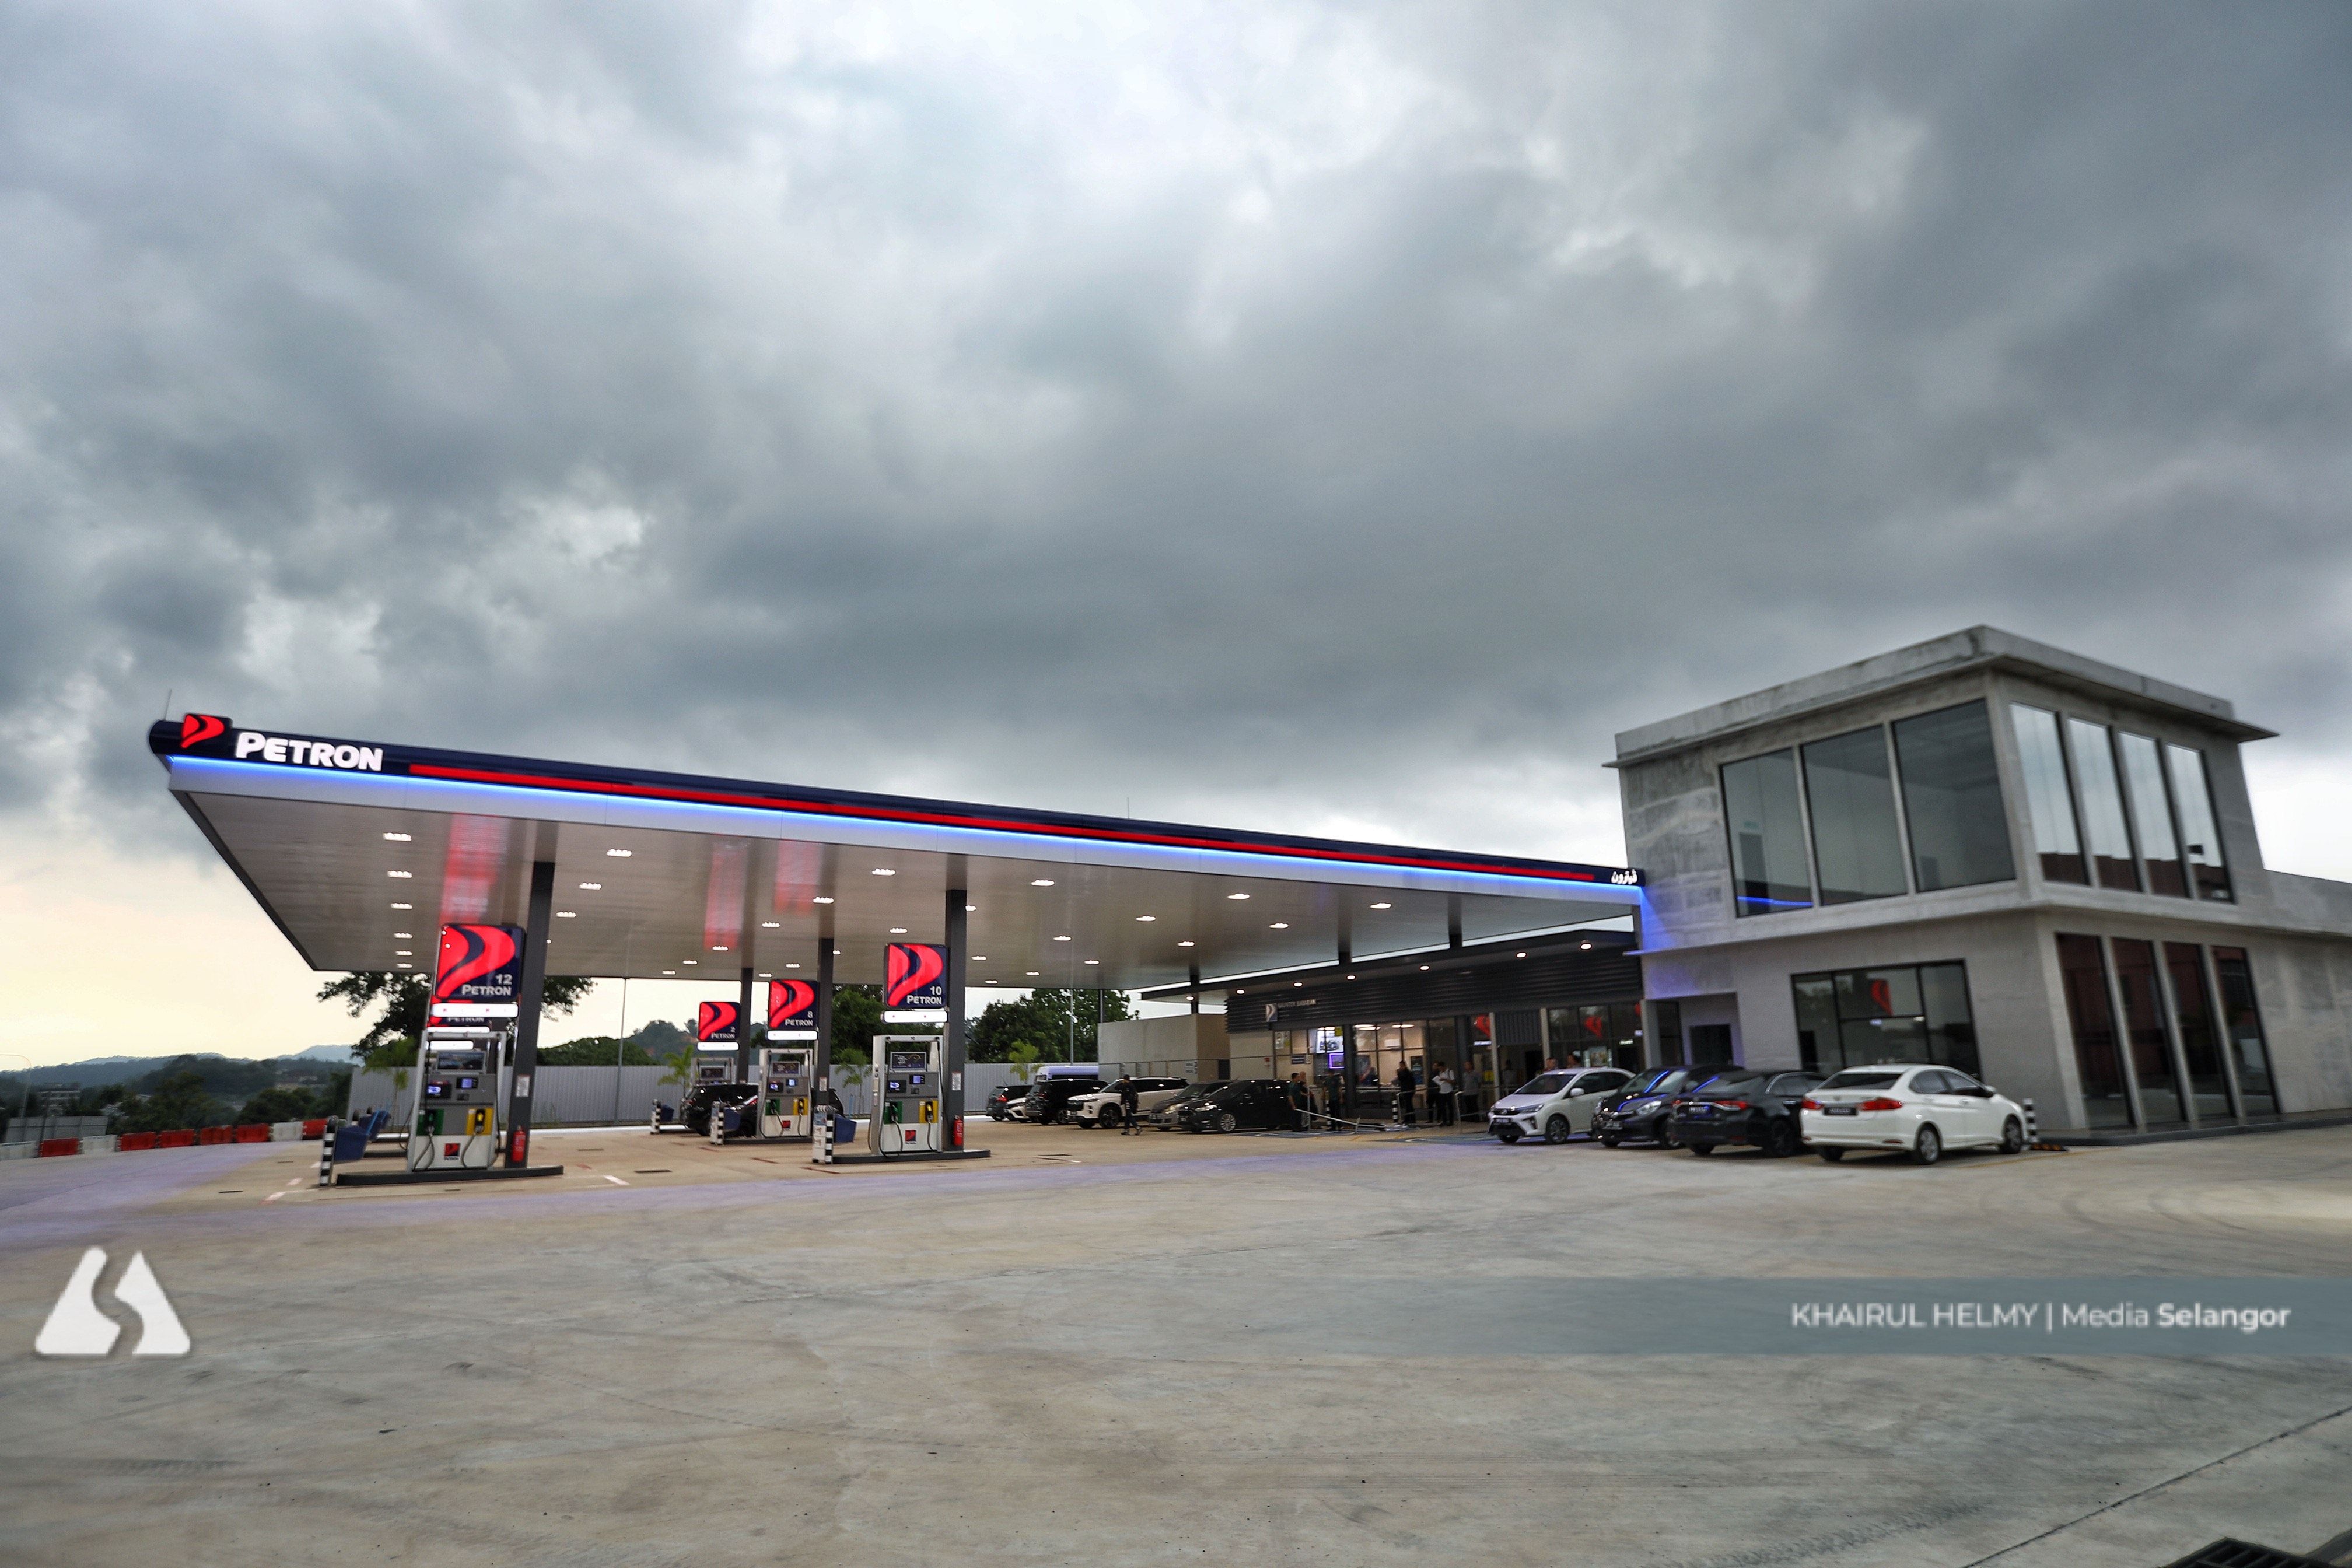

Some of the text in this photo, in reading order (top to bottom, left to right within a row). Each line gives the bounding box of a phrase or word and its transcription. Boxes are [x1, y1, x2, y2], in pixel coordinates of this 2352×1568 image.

[236, 731, 383, 771] PETRON
[496, 974, 513, 985] 12
[461, 984, 512, 996] PETRON
[930, 986, 942, 995] 10
[907, 995, 942, 1005] PETRON
[785, 1019, 813, 1027] PETRON
